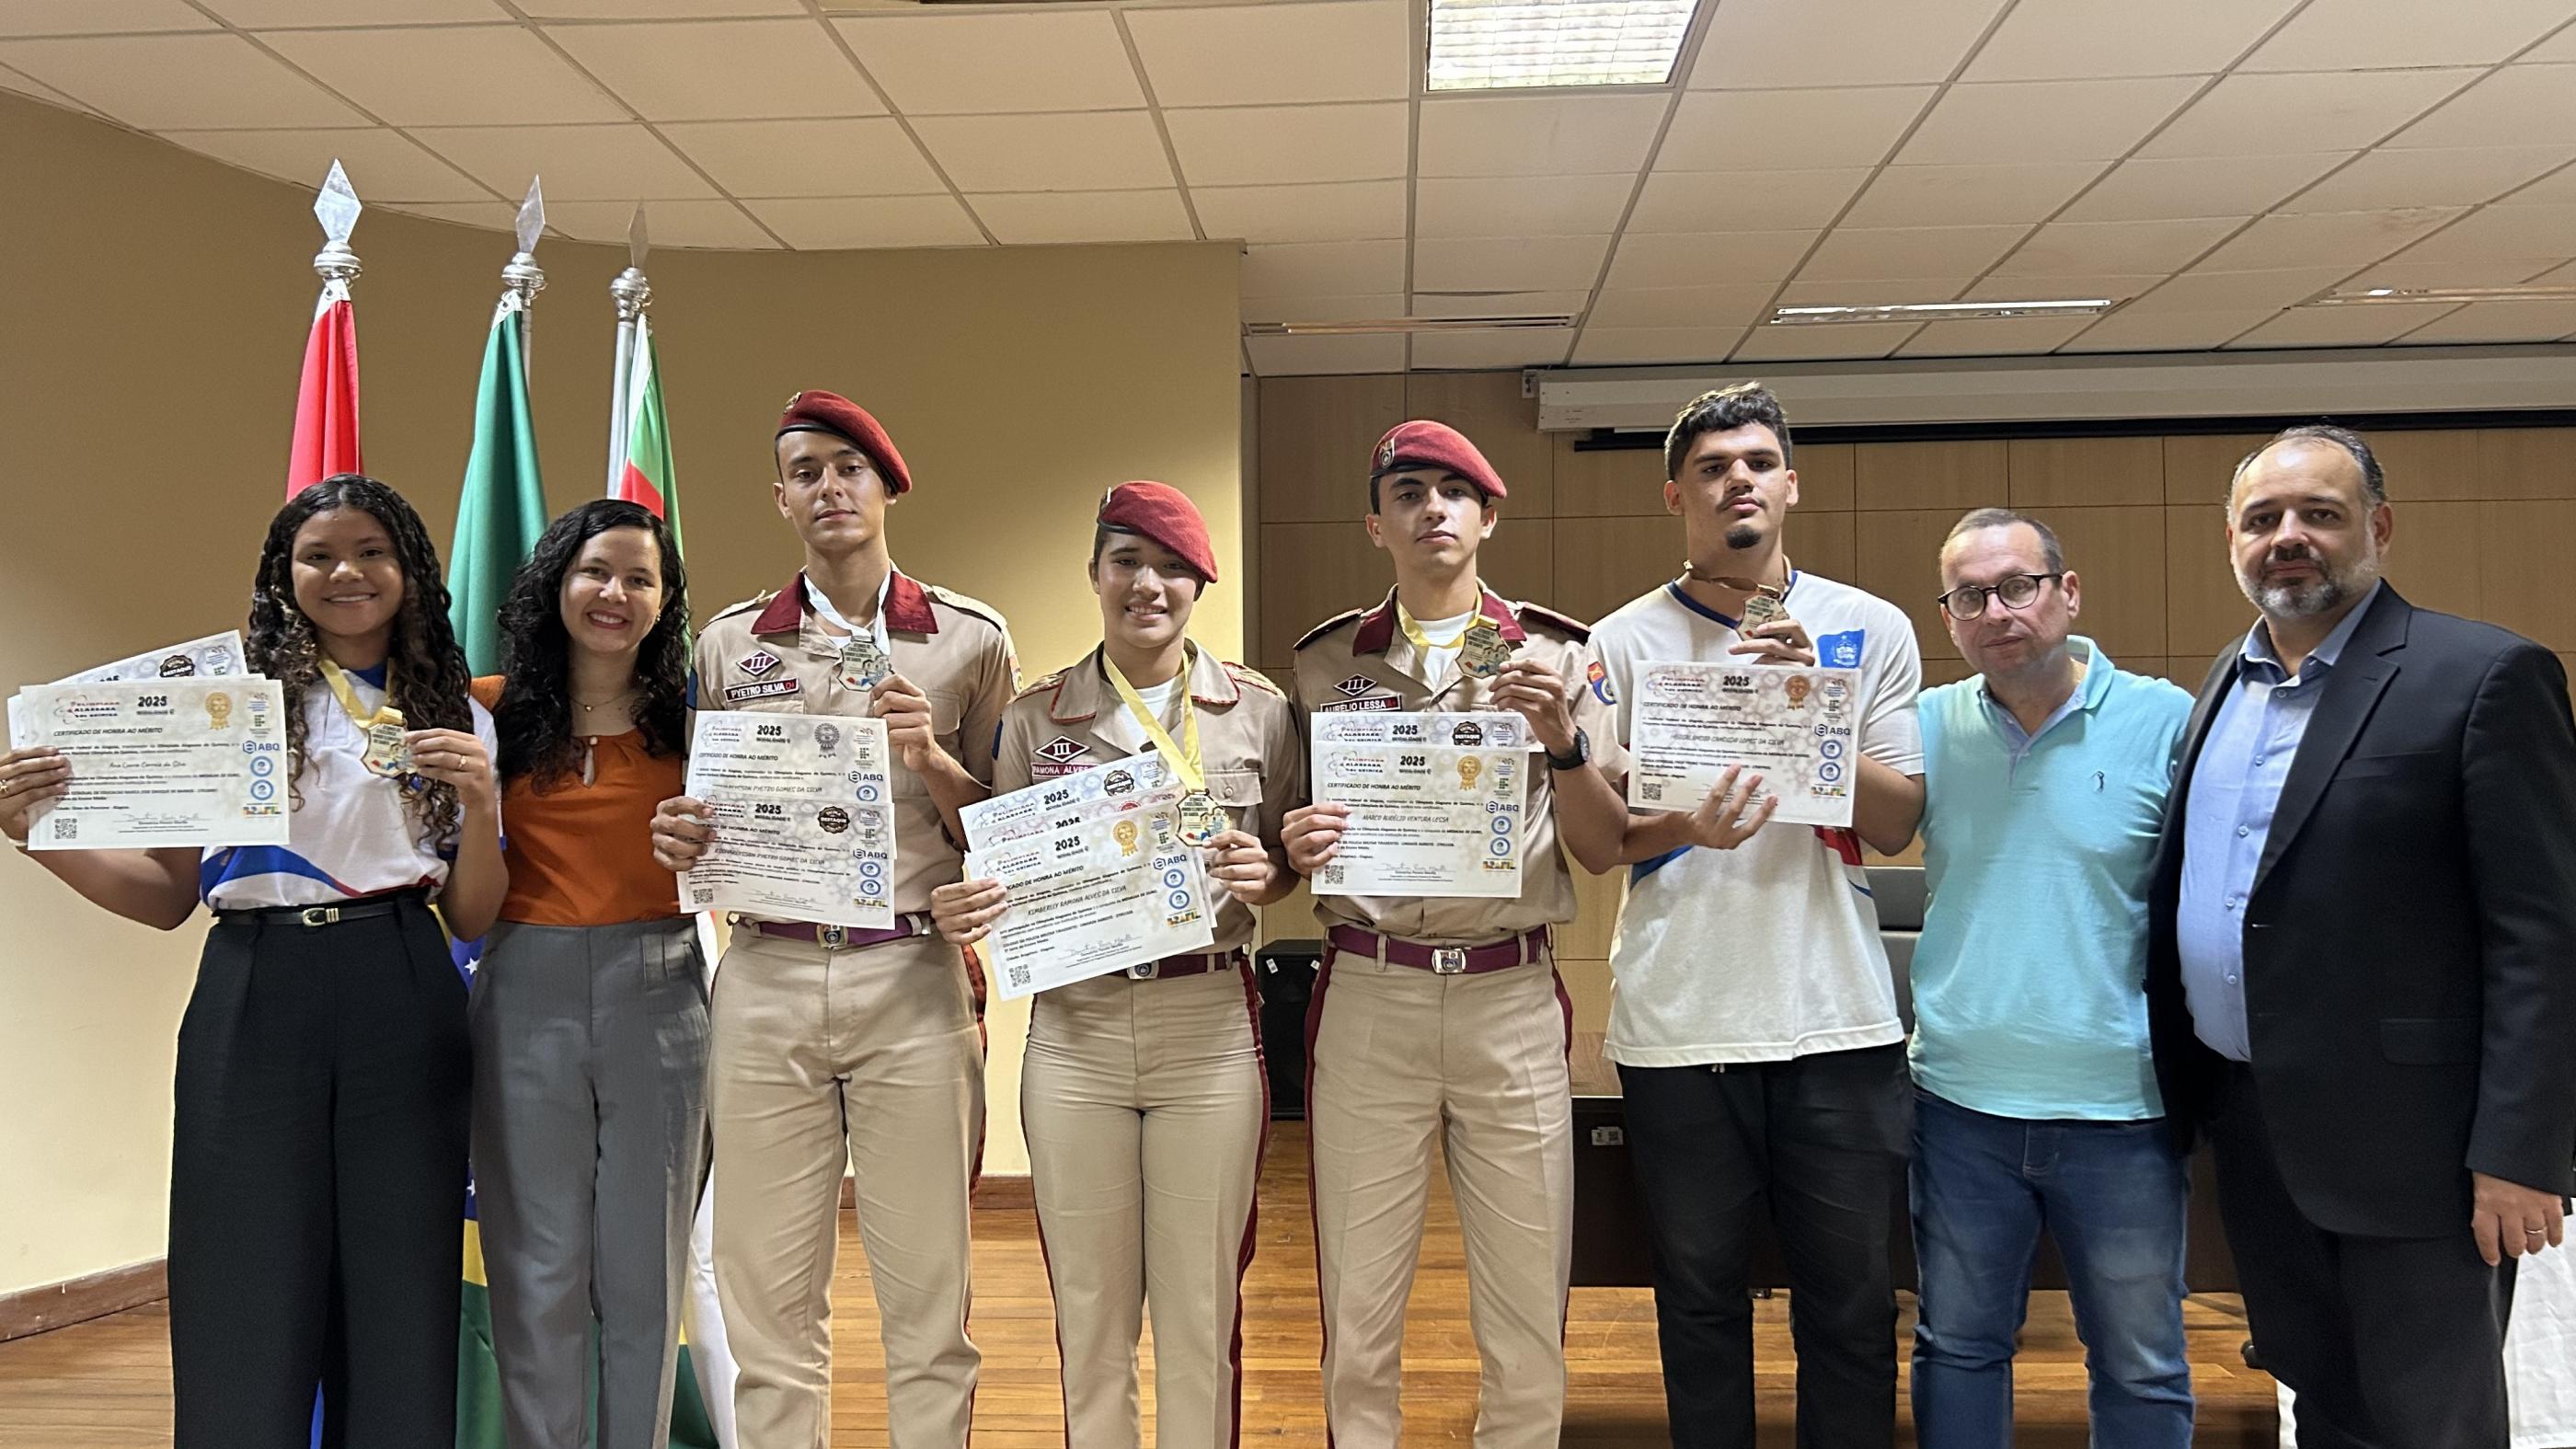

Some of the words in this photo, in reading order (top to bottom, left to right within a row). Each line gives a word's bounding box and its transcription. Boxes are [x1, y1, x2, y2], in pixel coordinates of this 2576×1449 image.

[1722, 675, 1750, 686] 2025
[730, 685, 761, 698] PYETRO
[762, 682, 786, 693] SILVA
[137, 696, 167, 707] 2025
[1359, 700, 1386, 710] LESSA
[53, 728, 92, 736] CERTIFICADO
[756, 724, 782, 736] 2025
[1392, 724, 1419, 735] 2025
[1829, 727, 1851, 736] ABQ
[258, 742, 281, 752] ABQ
[1399, 755, 1426, 766] 2025
[1032, 765, 1060, 775] RAMONA
[1400, 782, 1421, 790] MÉRITO
[1043, 788, 1070, 805] 2025
[754, 803, 782, 815] 2025
[1500, 803, 1519, 811] ABQ
[1054, 835, 1081, 851] 2025
[867, 851, 888, 859] ABQ
[1167, 854, 1188, 866] ABQ
[1025, 878, 1032, 886] DE
